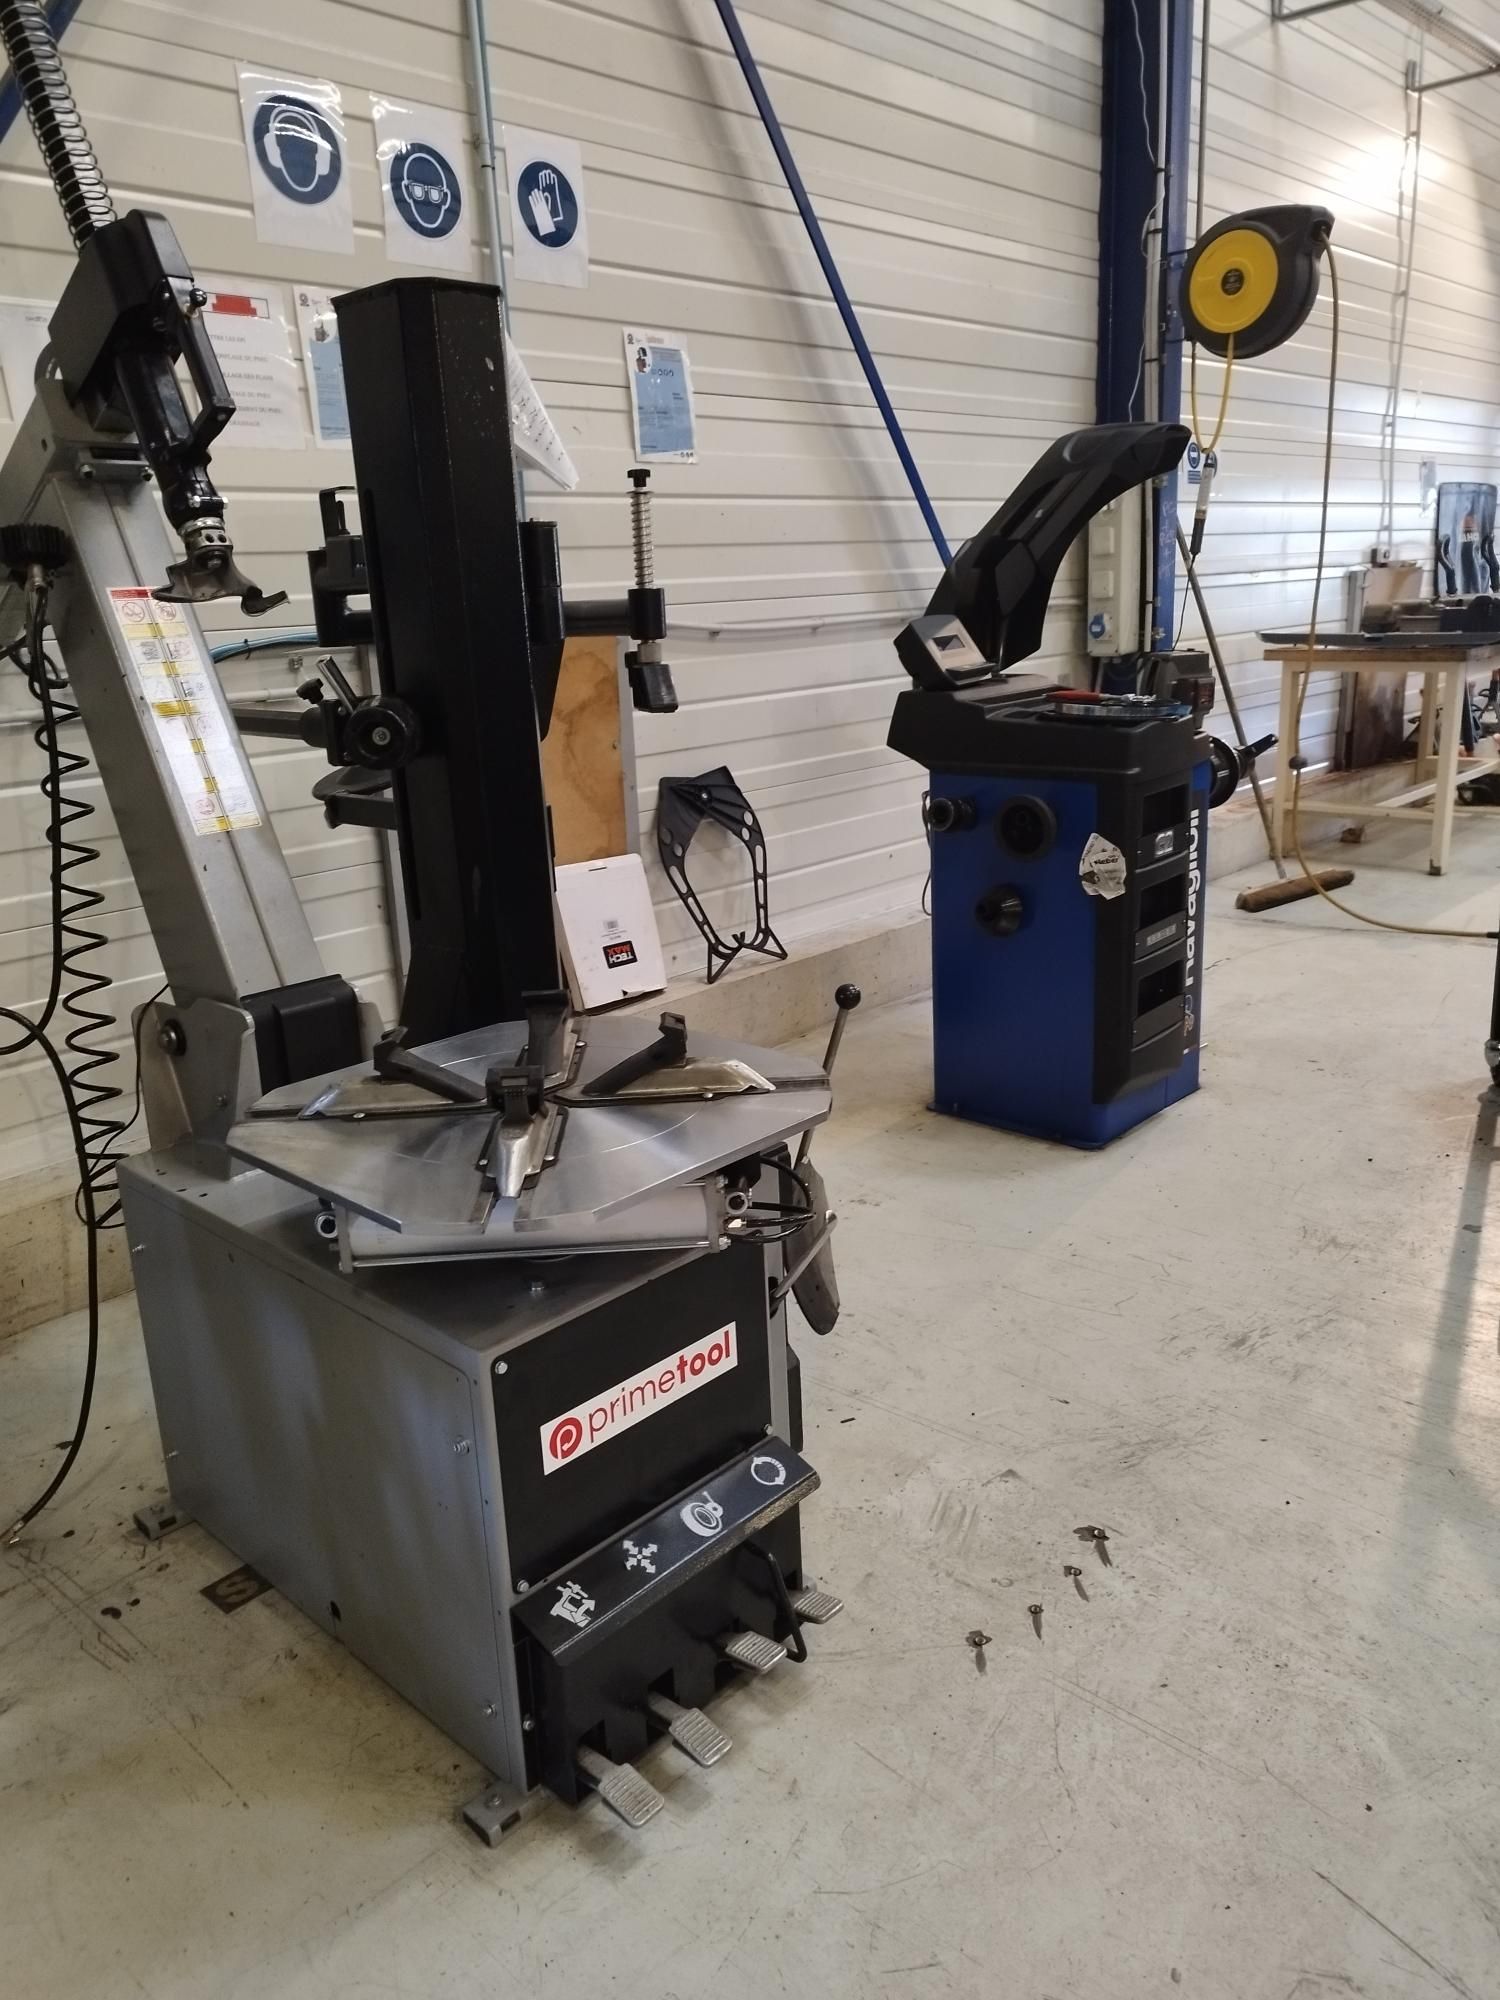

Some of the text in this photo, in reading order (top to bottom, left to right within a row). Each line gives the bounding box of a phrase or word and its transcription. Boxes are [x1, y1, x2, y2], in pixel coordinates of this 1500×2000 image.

[607, 944, 631, 955] MAX
[609, 953, 635, 964] TECH
[588, 1330, 730, 1443] primetool
